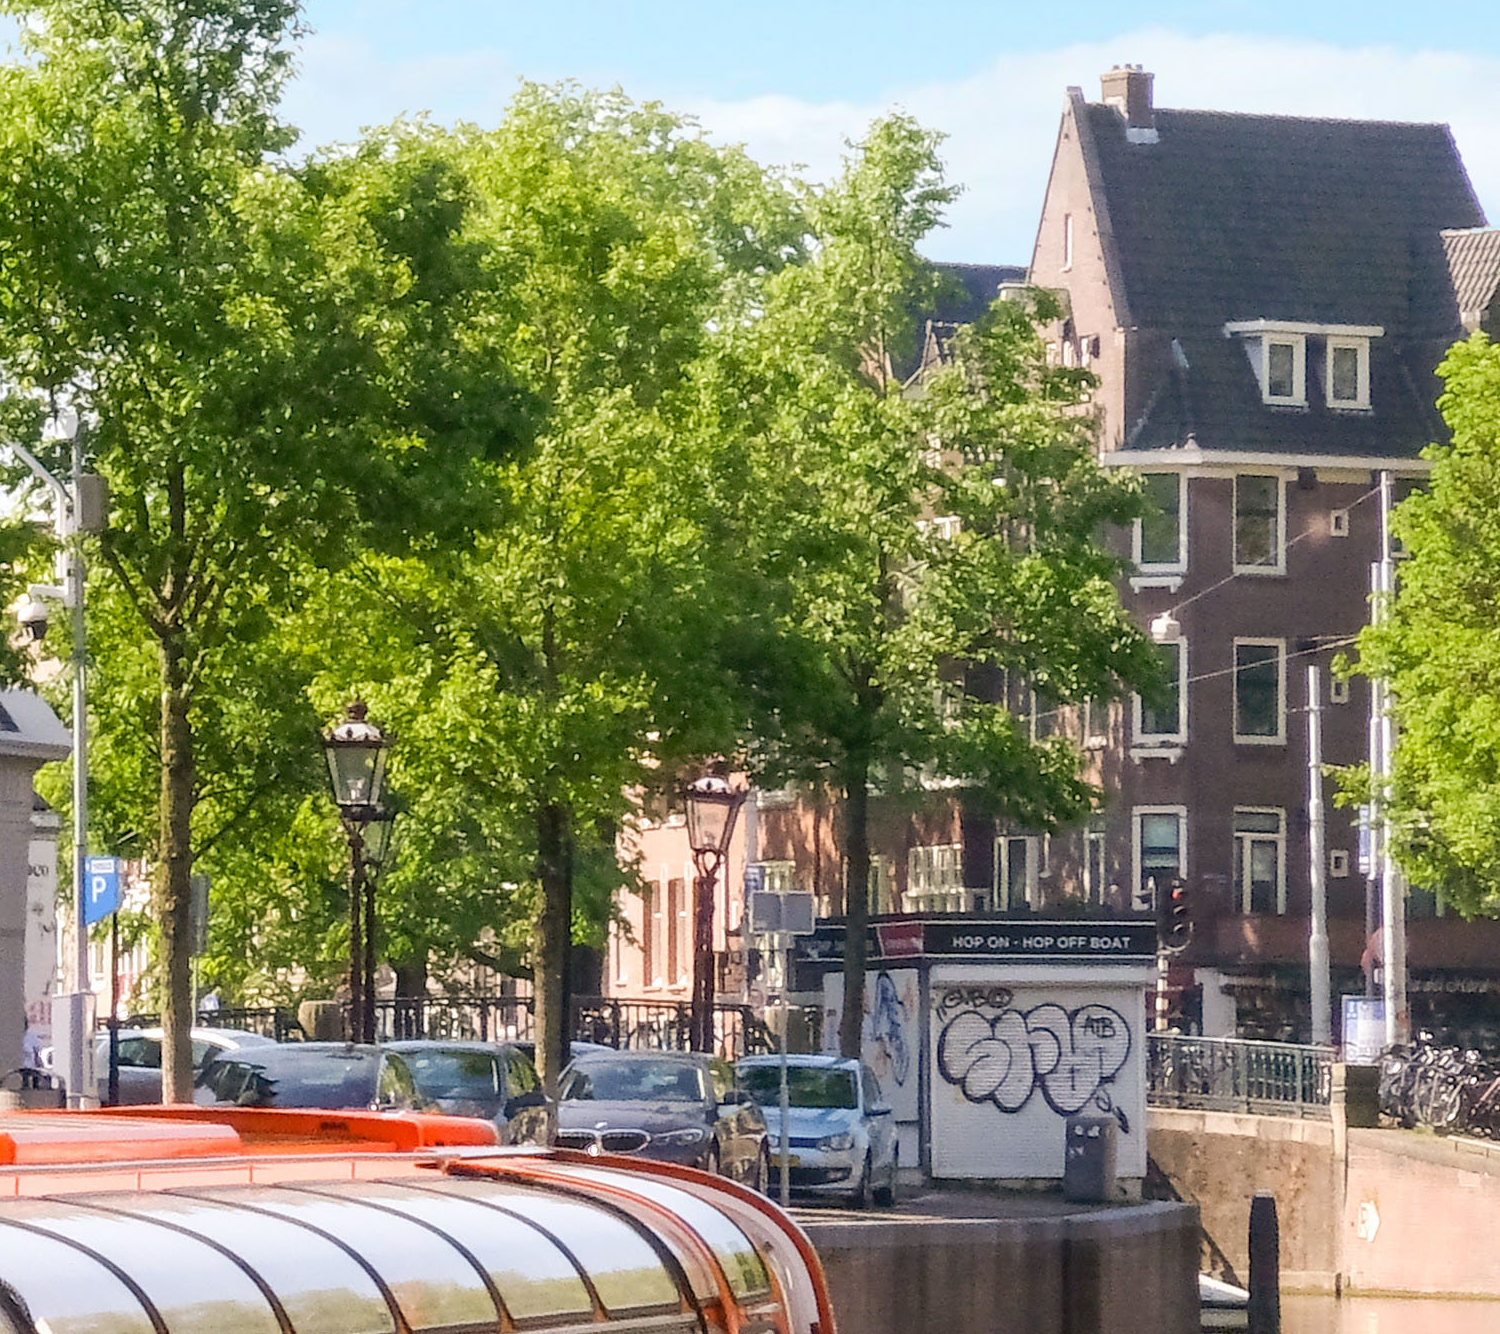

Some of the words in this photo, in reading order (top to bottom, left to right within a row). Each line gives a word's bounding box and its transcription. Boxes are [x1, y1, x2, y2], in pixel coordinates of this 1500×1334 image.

[92, 875, 107, 903] P
[953, 936, 983, 948] HOP
[987, 936, 1009, 948] ON
[1023, 936, 1053, 948] HOP
[1057, 936, 1086, 948] OFF
[1091, 936, 1130, 949] BOAT
